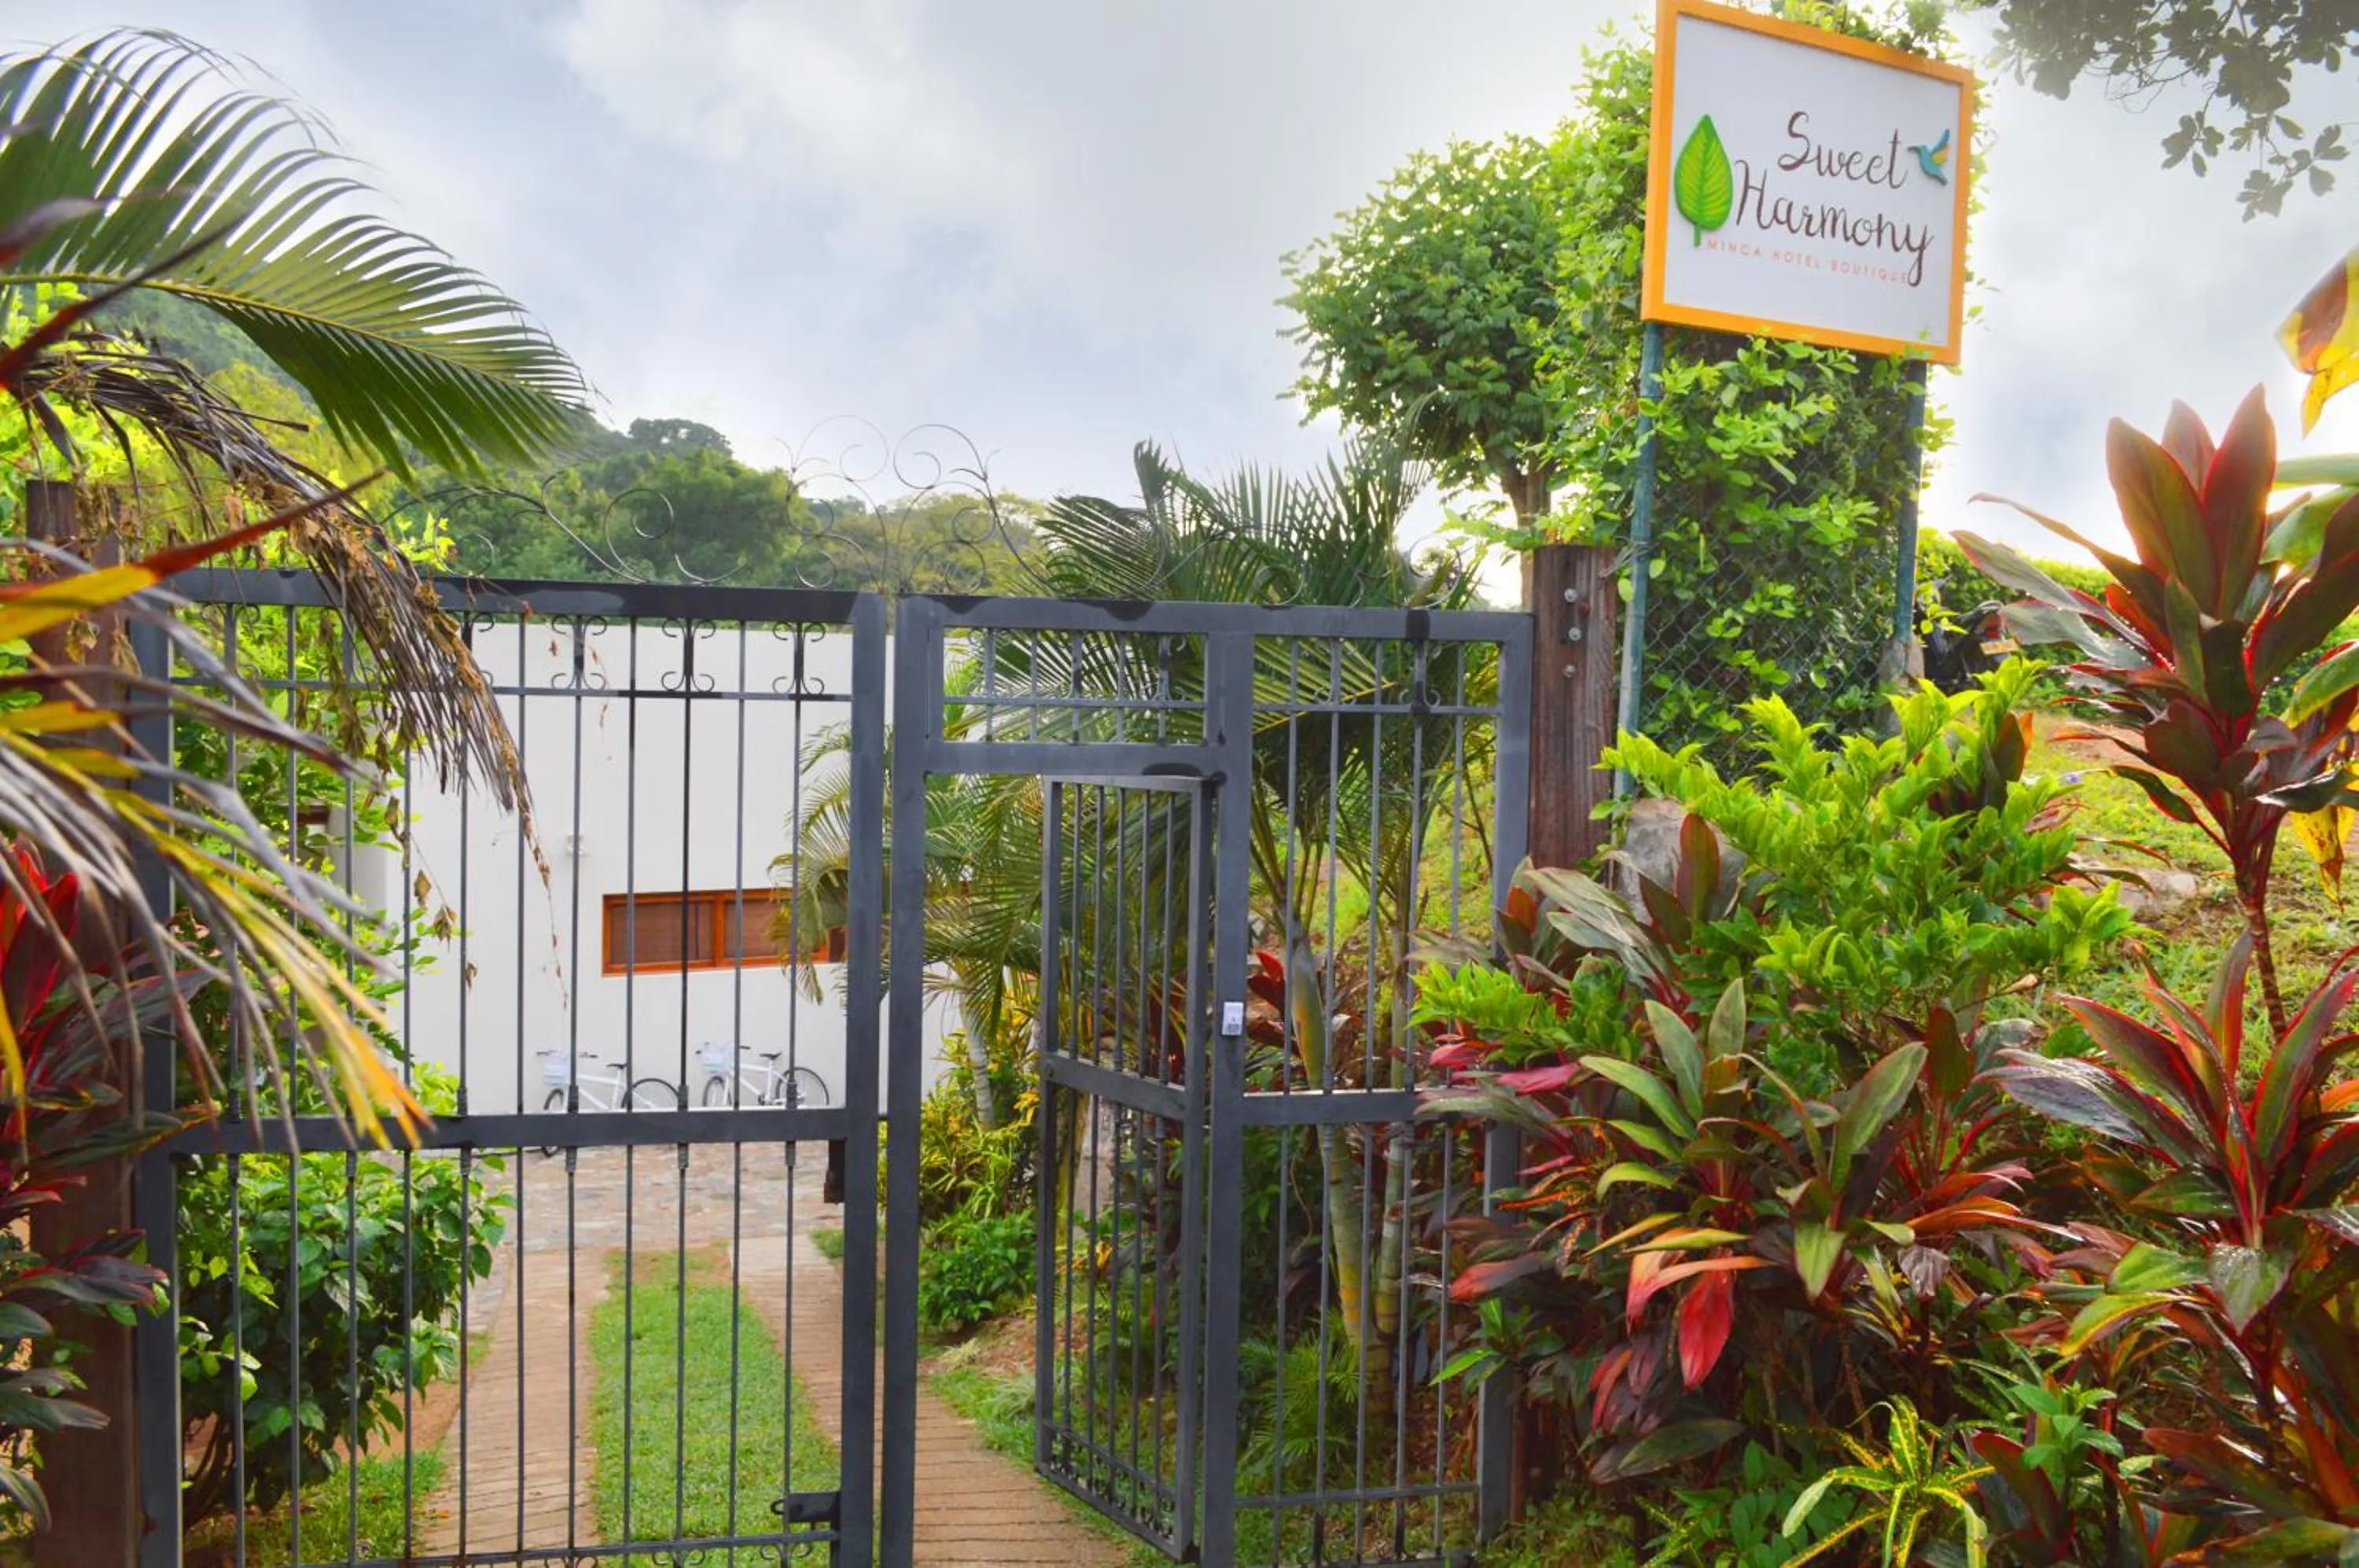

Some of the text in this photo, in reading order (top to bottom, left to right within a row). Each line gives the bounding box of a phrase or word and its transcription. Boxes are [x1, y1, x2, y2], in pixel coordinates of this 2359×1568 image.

[1778, 111, 1908, 189] Sweet
[1707, 237, 1907, 285] MINCA HOTEL BOUTIQUE
[1735, 160, 1934, 287] Harmony
